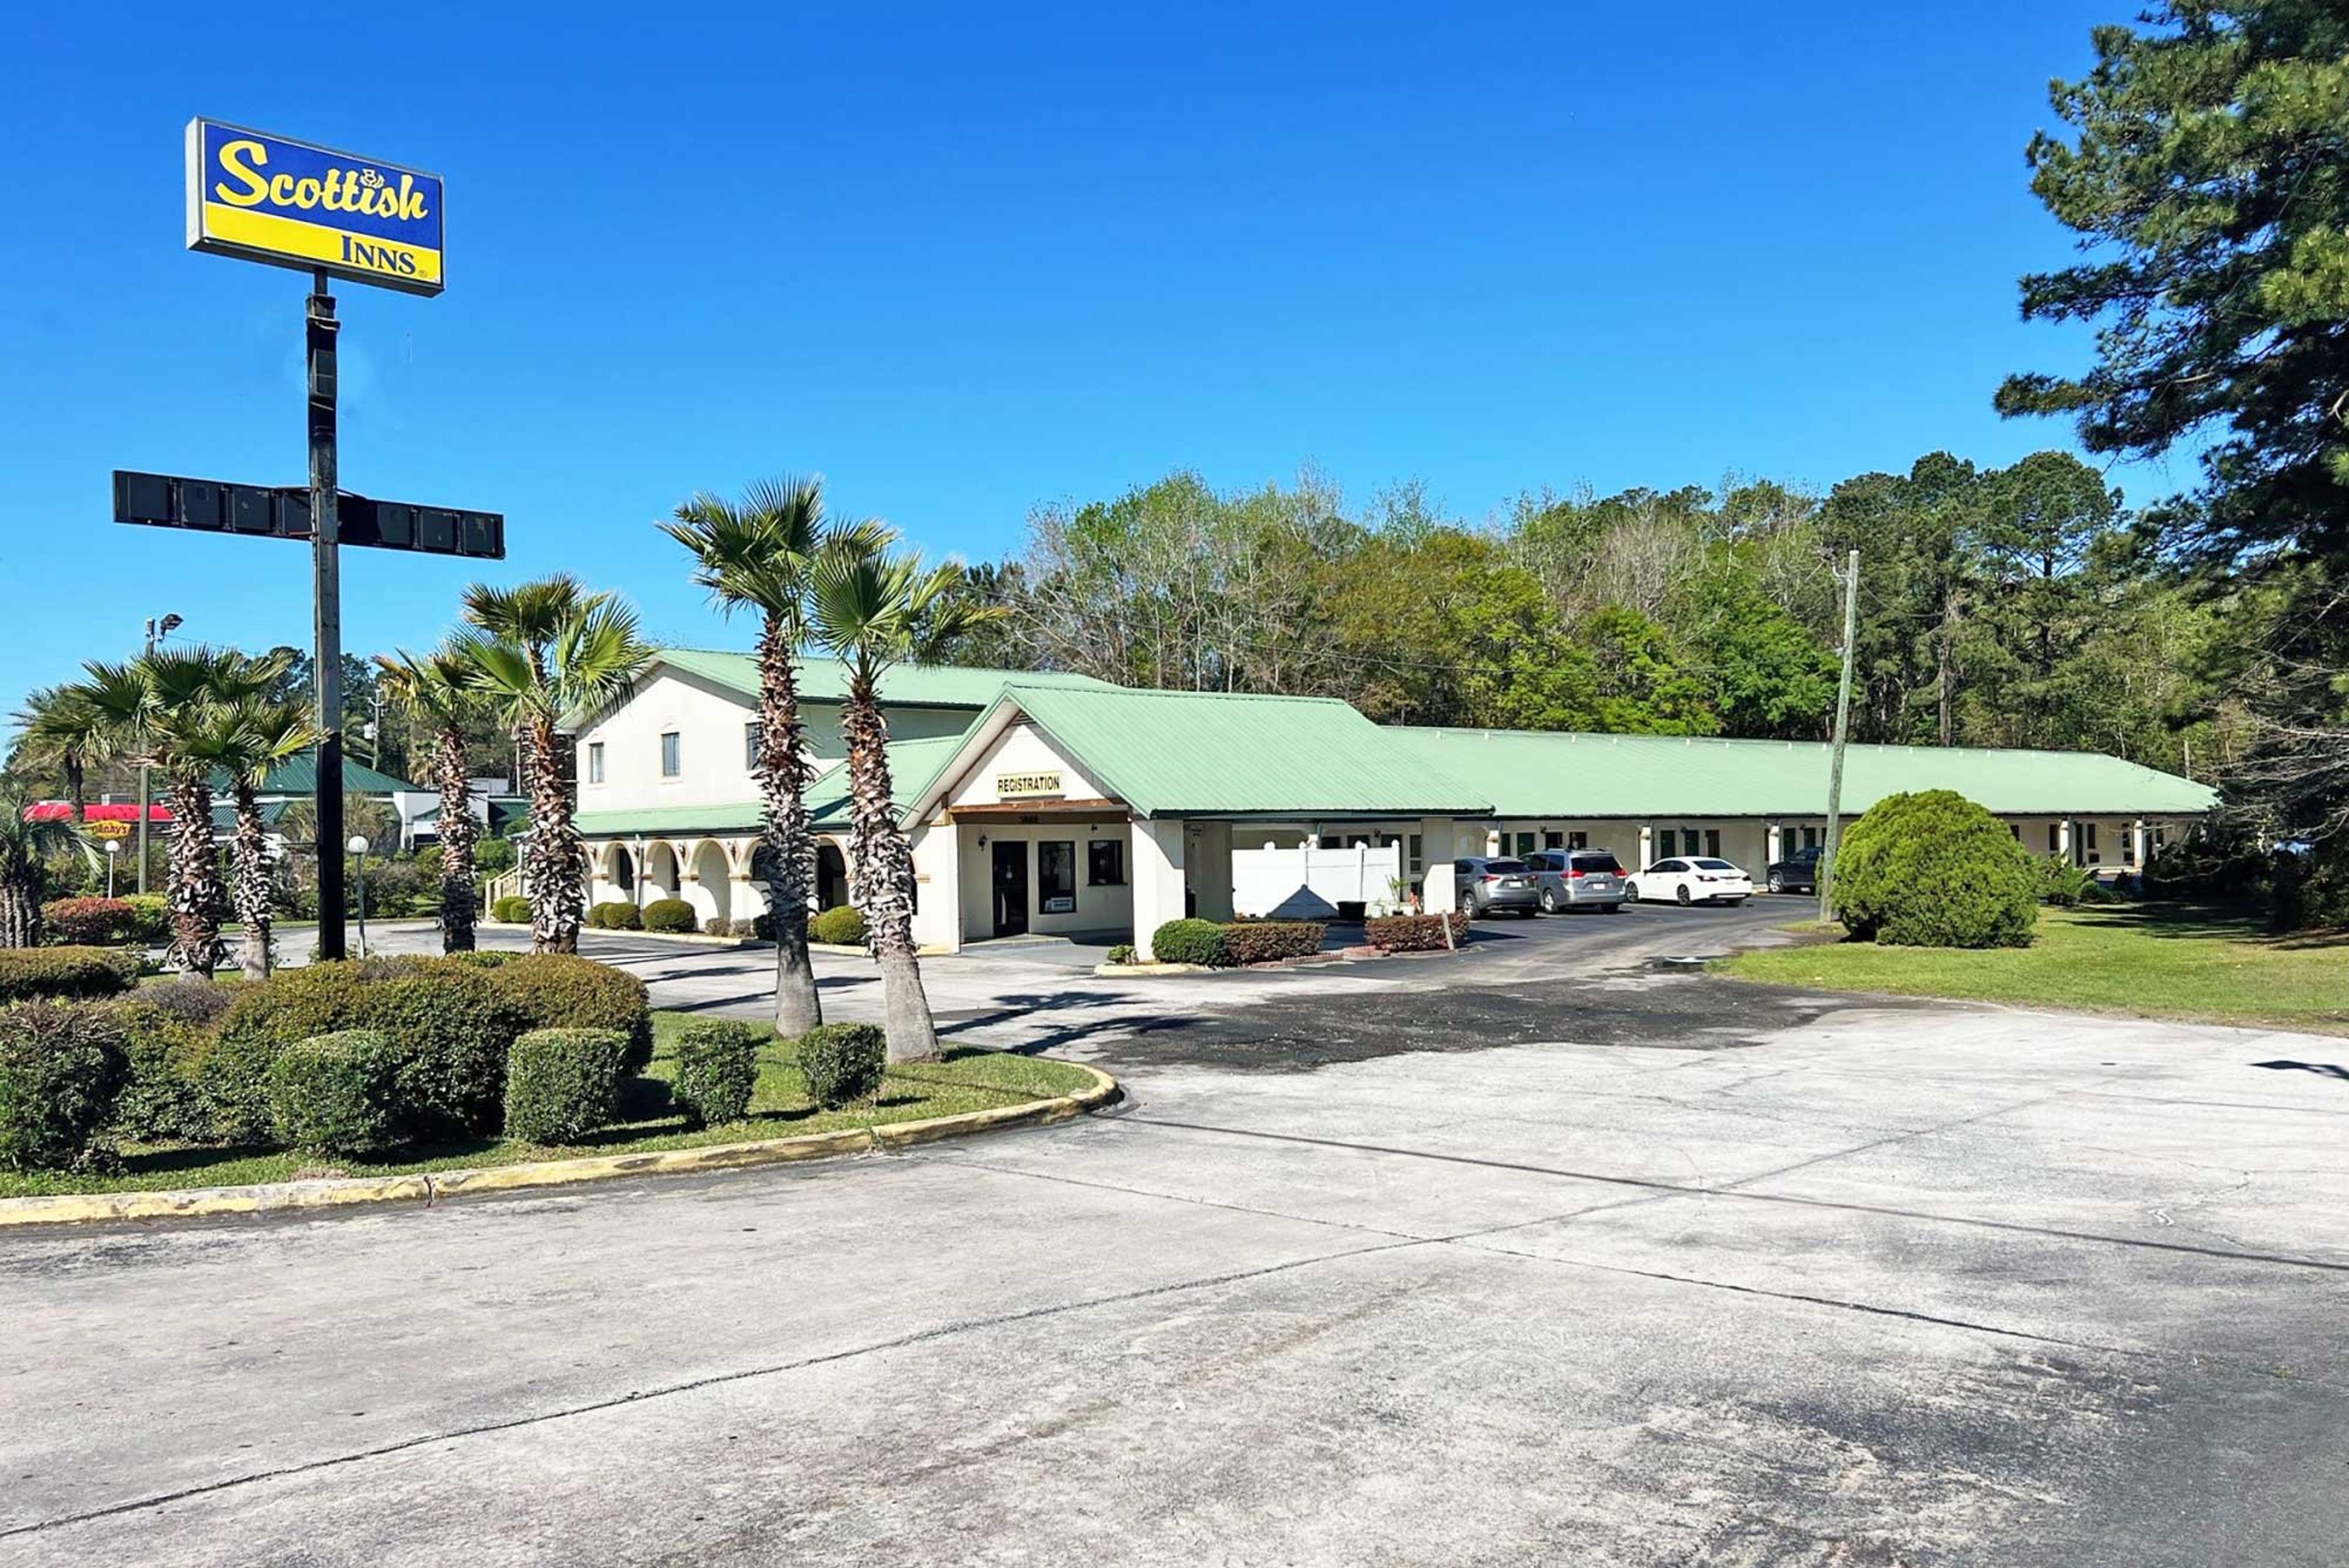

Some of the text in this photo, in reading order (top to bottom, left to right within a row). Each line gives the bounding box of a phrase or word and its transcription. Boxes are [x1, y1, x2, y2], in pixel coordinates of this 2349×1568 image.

[215, 140, 428, 220] Scottish
[341, 235, 416, 275] INNS
[998, 776, 1059, 792] REGISTRATION
